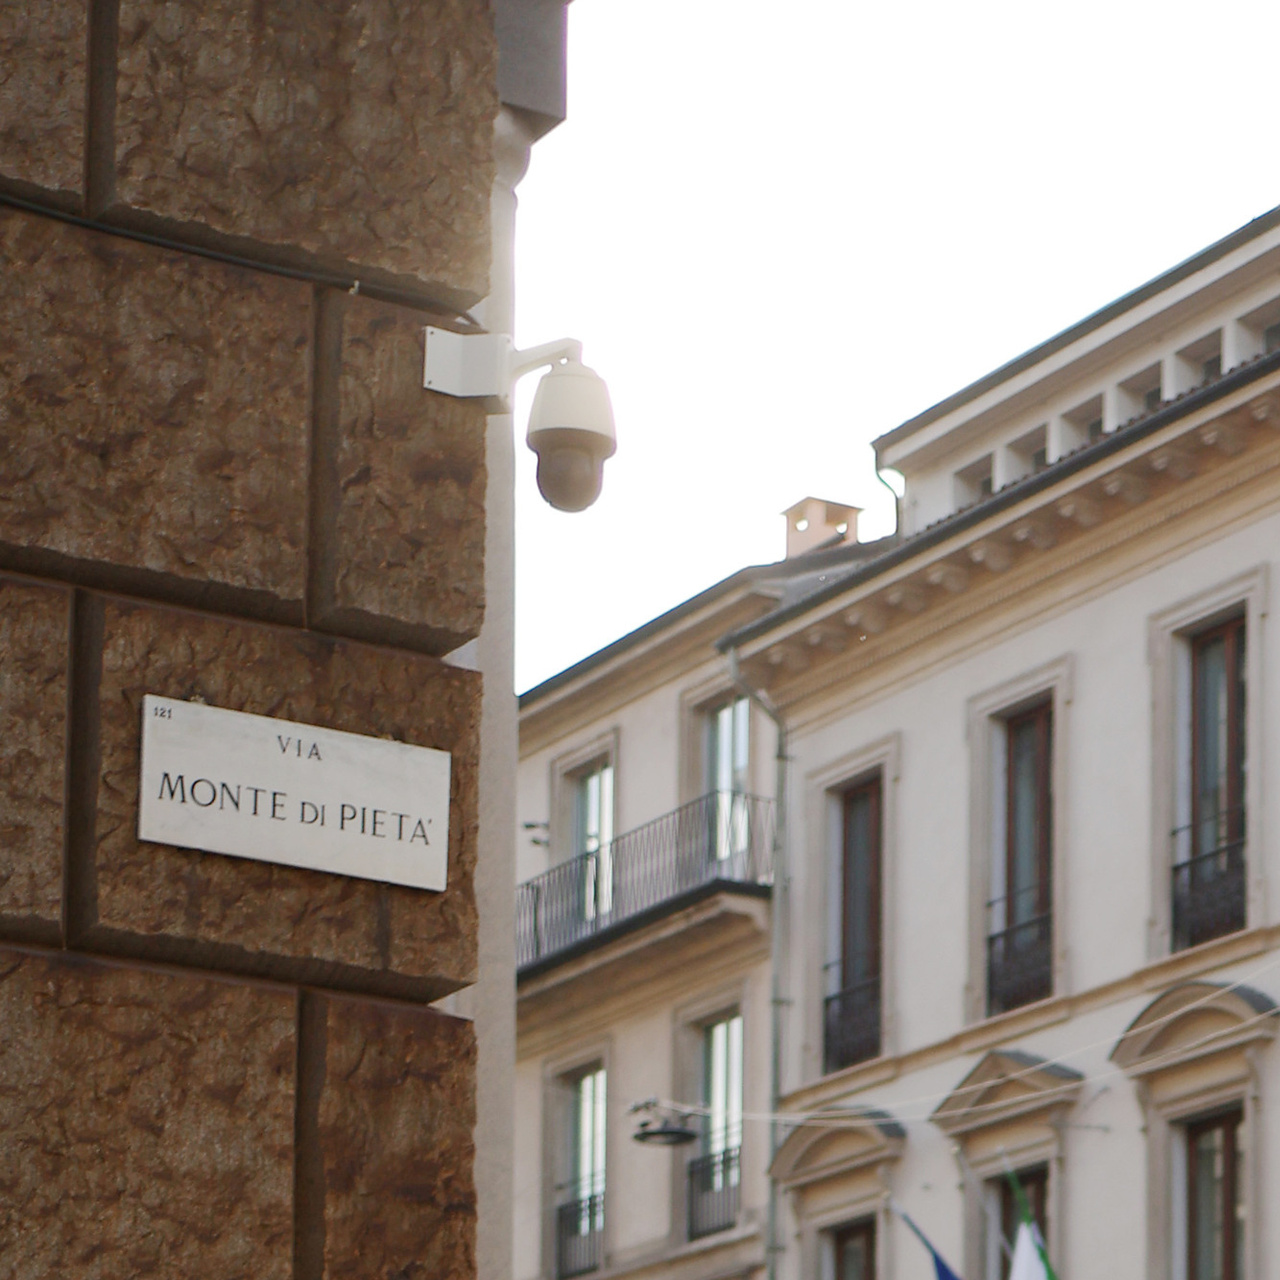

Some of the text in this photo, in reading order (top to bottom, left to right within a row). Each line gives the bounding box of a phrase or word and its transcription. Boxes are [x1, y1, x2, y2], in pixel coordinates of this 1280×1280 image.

[154, 706, 172, 719] 121
[277, 735, 323, 761] VIA
[158, 772, 288, 821] MONTE
[300, 801, 326, 827] DI
